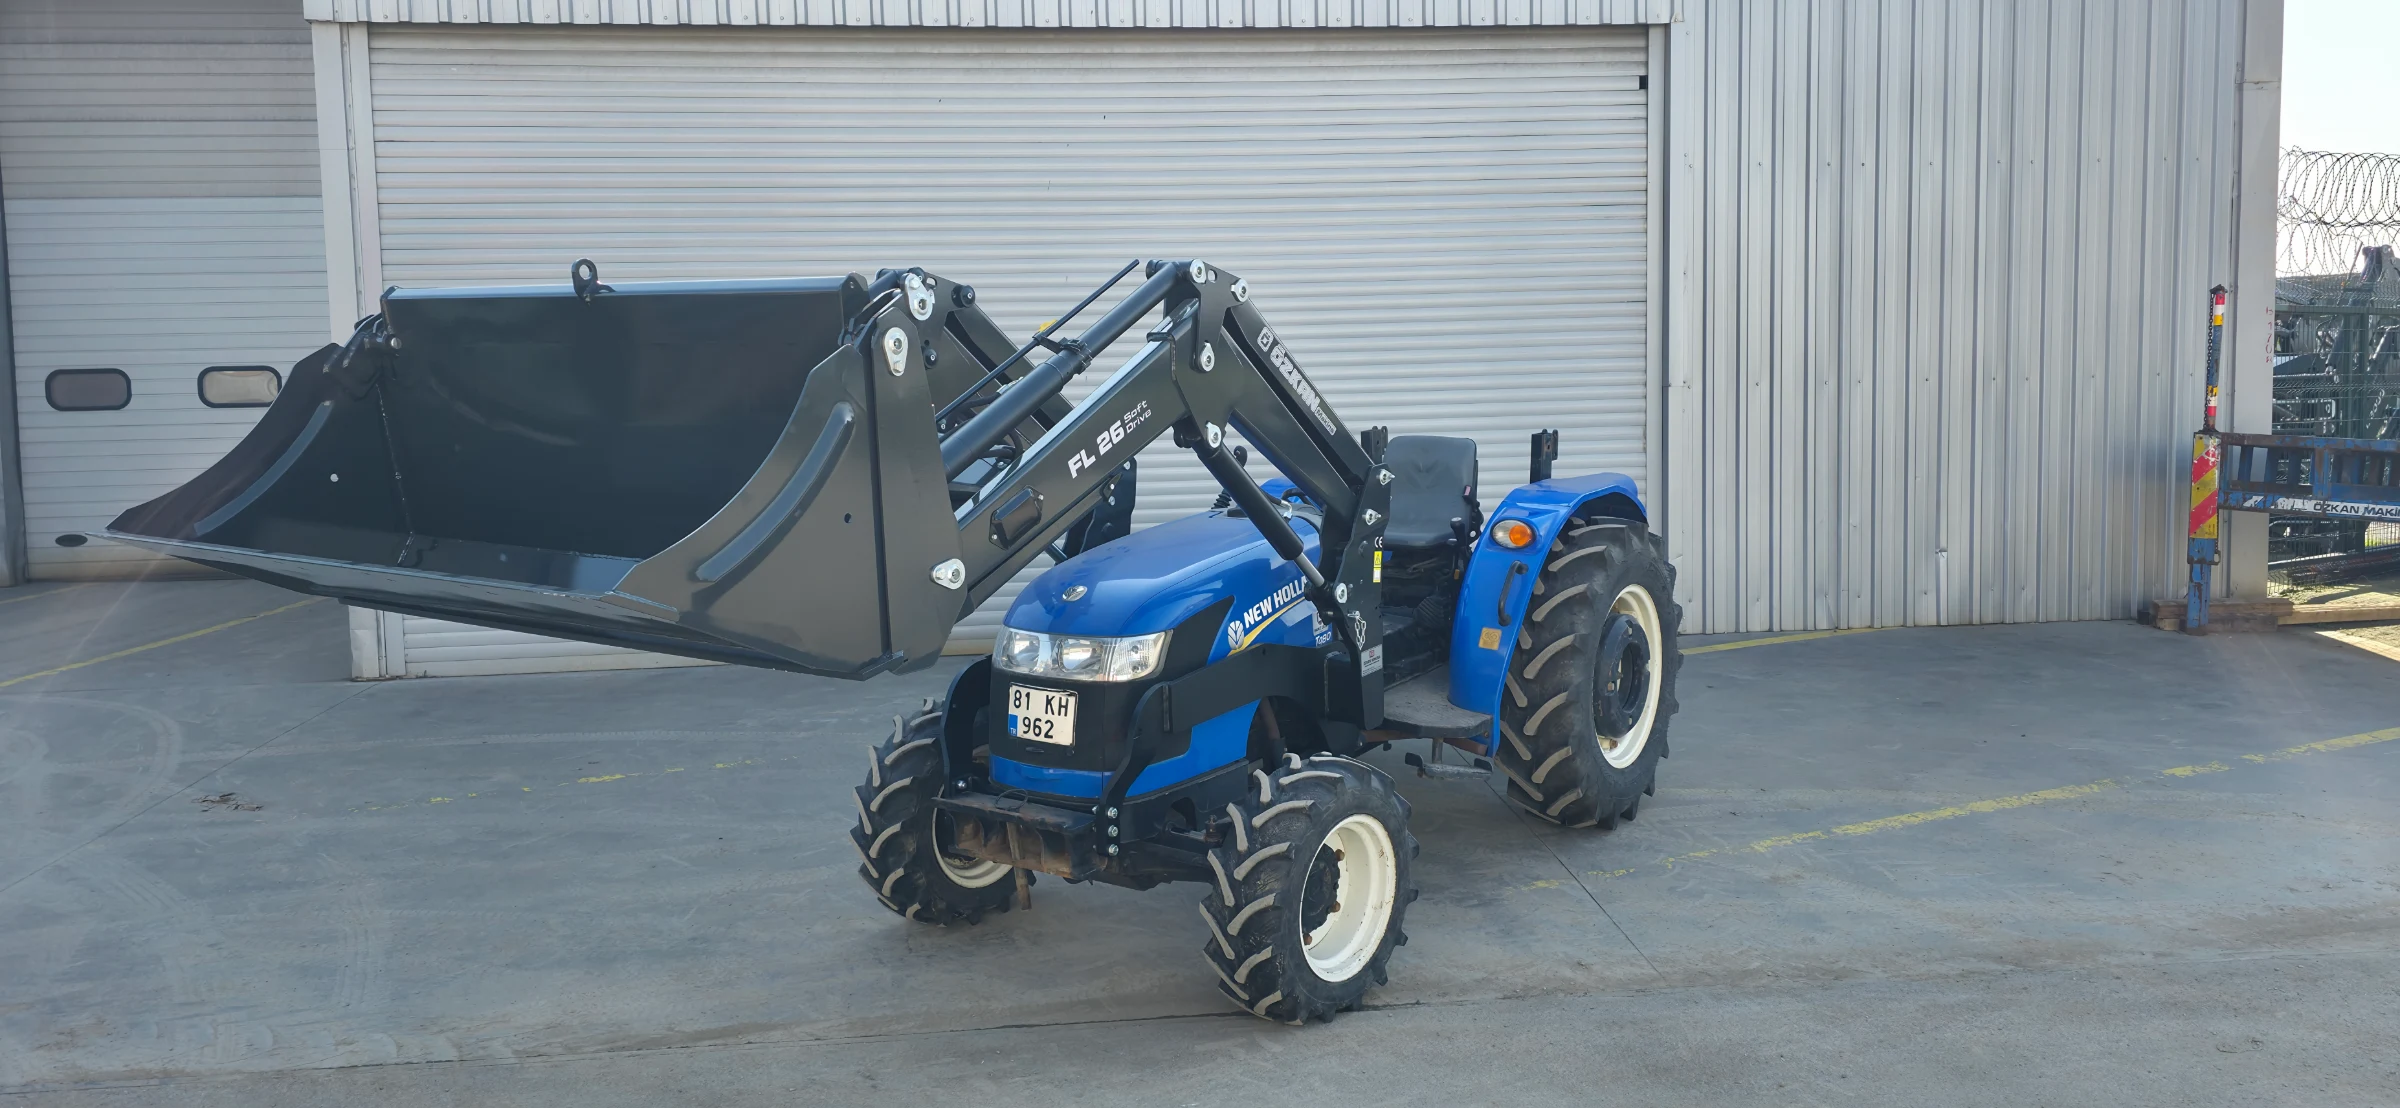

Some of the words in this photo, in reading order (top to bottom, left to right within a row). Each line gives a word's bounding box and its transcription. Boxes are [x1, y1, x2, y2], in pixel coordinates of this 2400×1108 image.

[1123, 400, 1147, 423] Soft
[1126, 409, 1152, 434] Drive
[1067, 449, 1096, 479] FL
[1096, 420, 1124, 456] 26
[2313, 501, 2359, 514] ÖZKAN
[2362, 505, 2400, 517] MAKİ
[1243, 596, 1273, 629] NEW
[1013, 690, 1031, 711] 81
[1045, 694, 1070, 717] KH
[1022, 716, 1054, 739] 962
